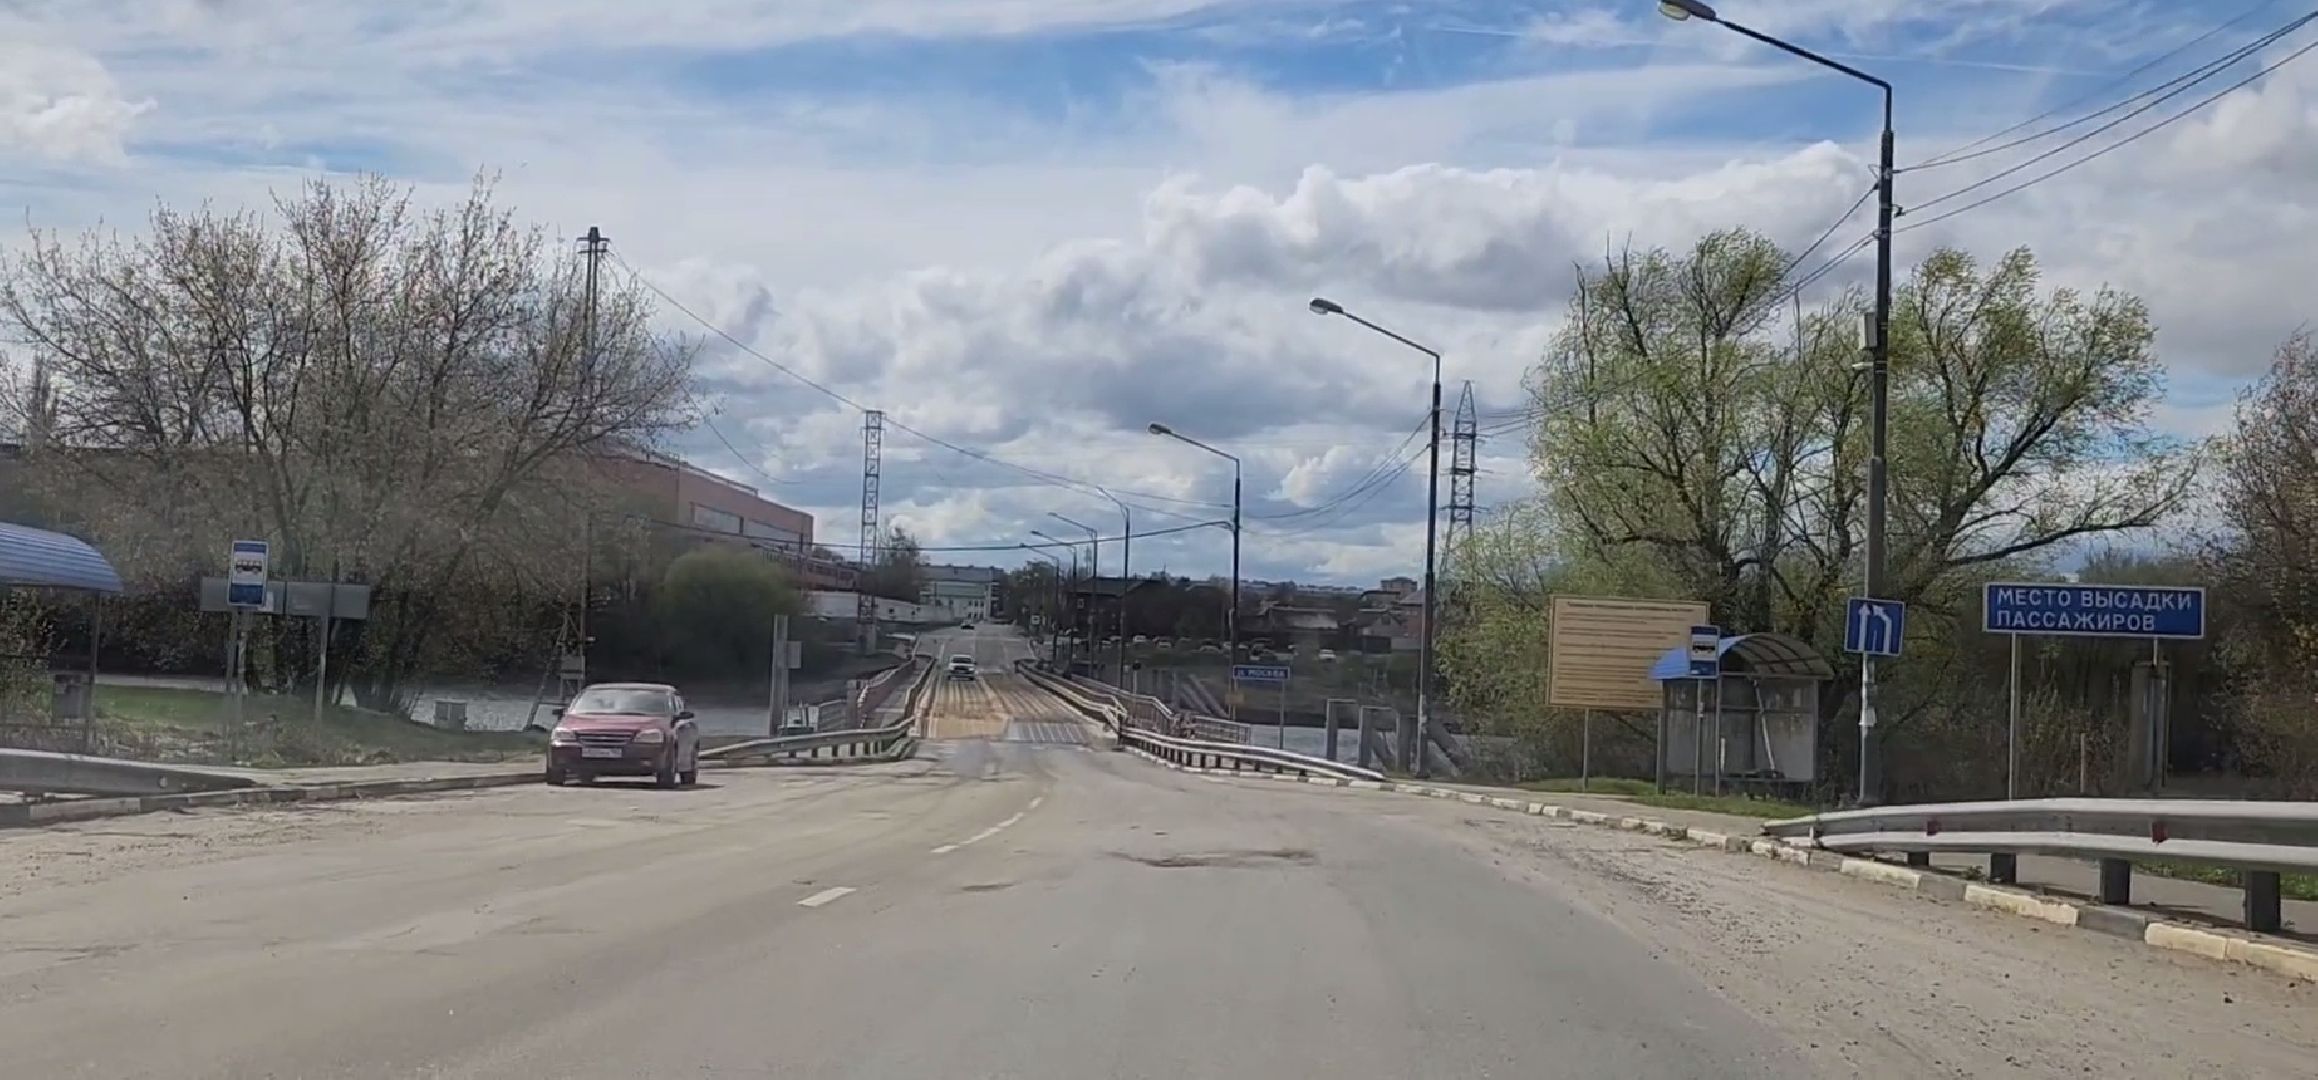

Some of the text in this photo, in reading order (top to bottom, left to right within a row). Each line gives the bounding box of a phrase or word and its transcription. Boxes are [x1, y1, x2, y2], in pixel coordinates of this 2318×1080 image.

[1997, 588, 2192, 612] МЕСТО ВЫСАДКИ
[1997, 610, 2155, 631] ПАССАЖИРОВ
